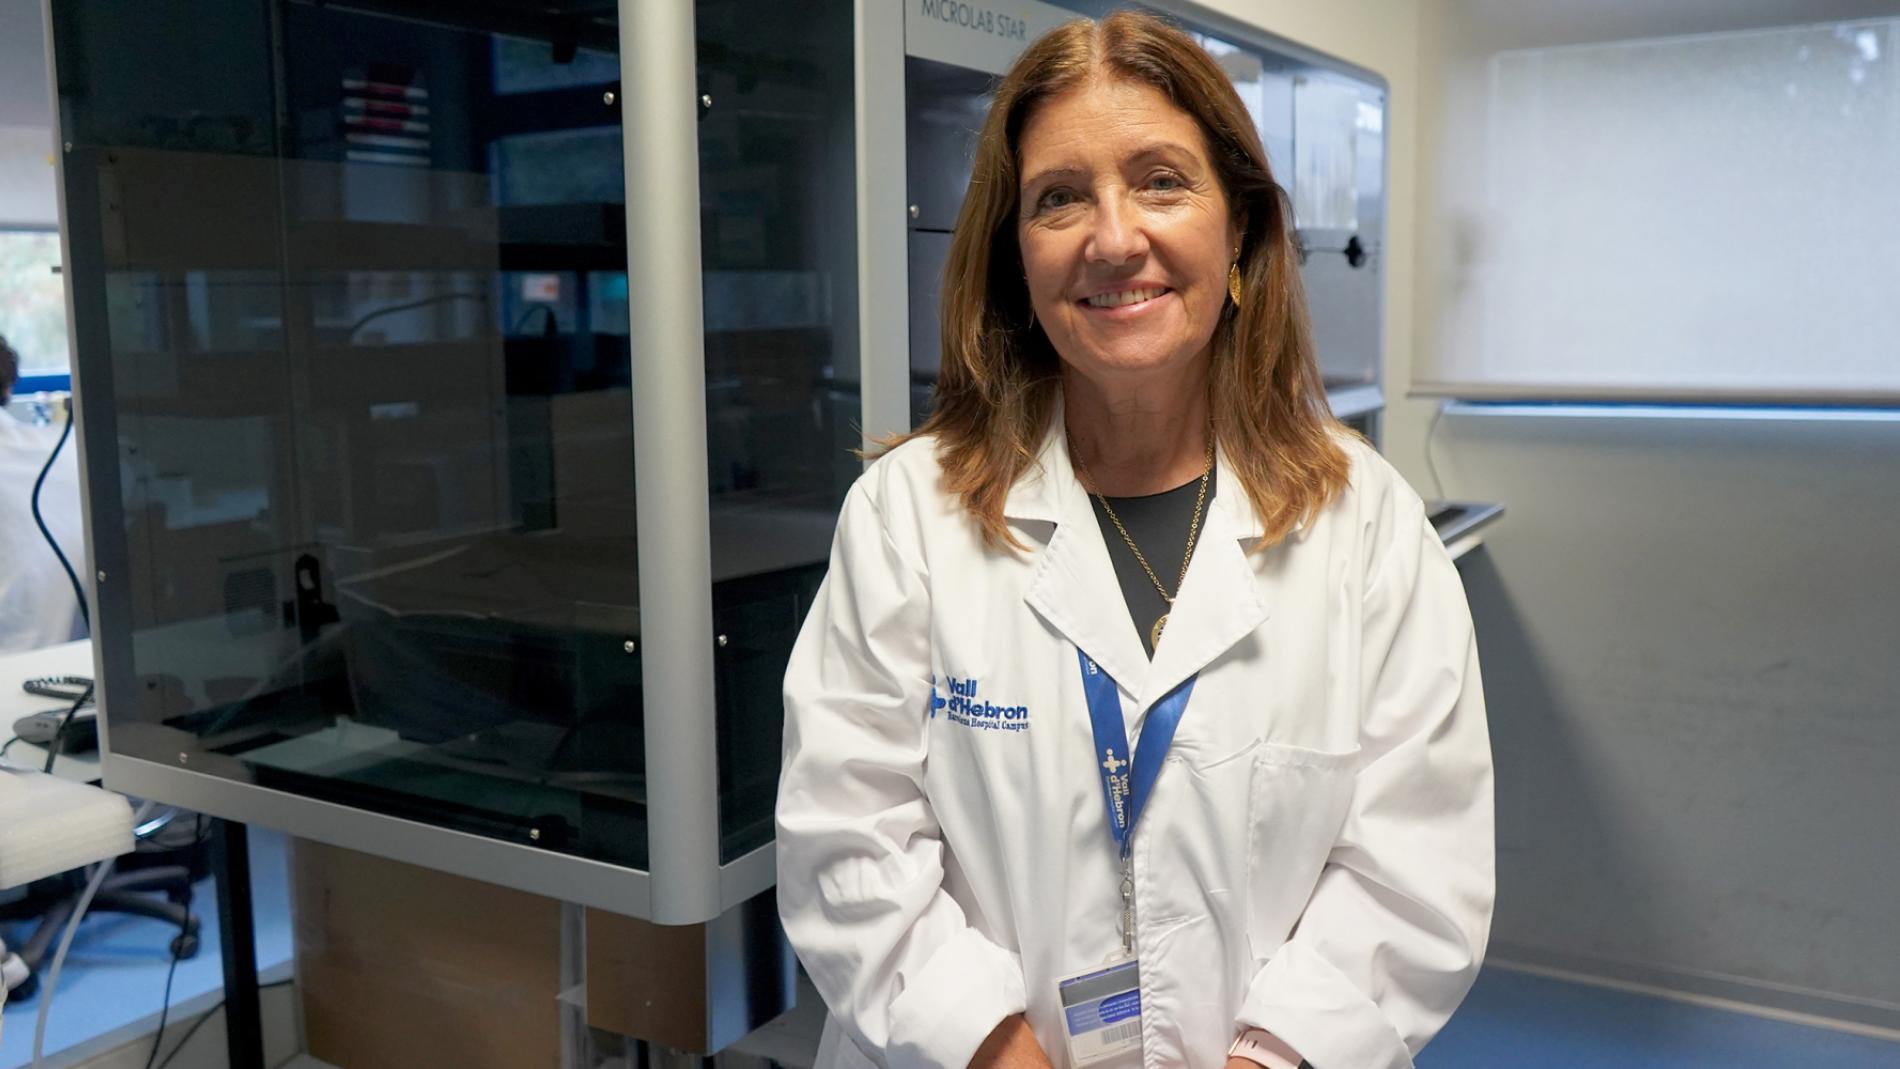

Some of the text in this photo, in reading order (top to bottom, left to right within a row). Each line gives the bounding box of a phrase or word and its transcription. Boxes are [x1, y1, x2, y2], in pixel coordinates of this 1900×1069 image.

[921, 0, 1026, 41] MICROLAB STAR
[946, 675, 977, 698] Vall
[970, 717, 1001, 730] Hospital
[1120, 773, 1130, 796] Vall
[1110, 774, 1125, 828] d'Hebron
